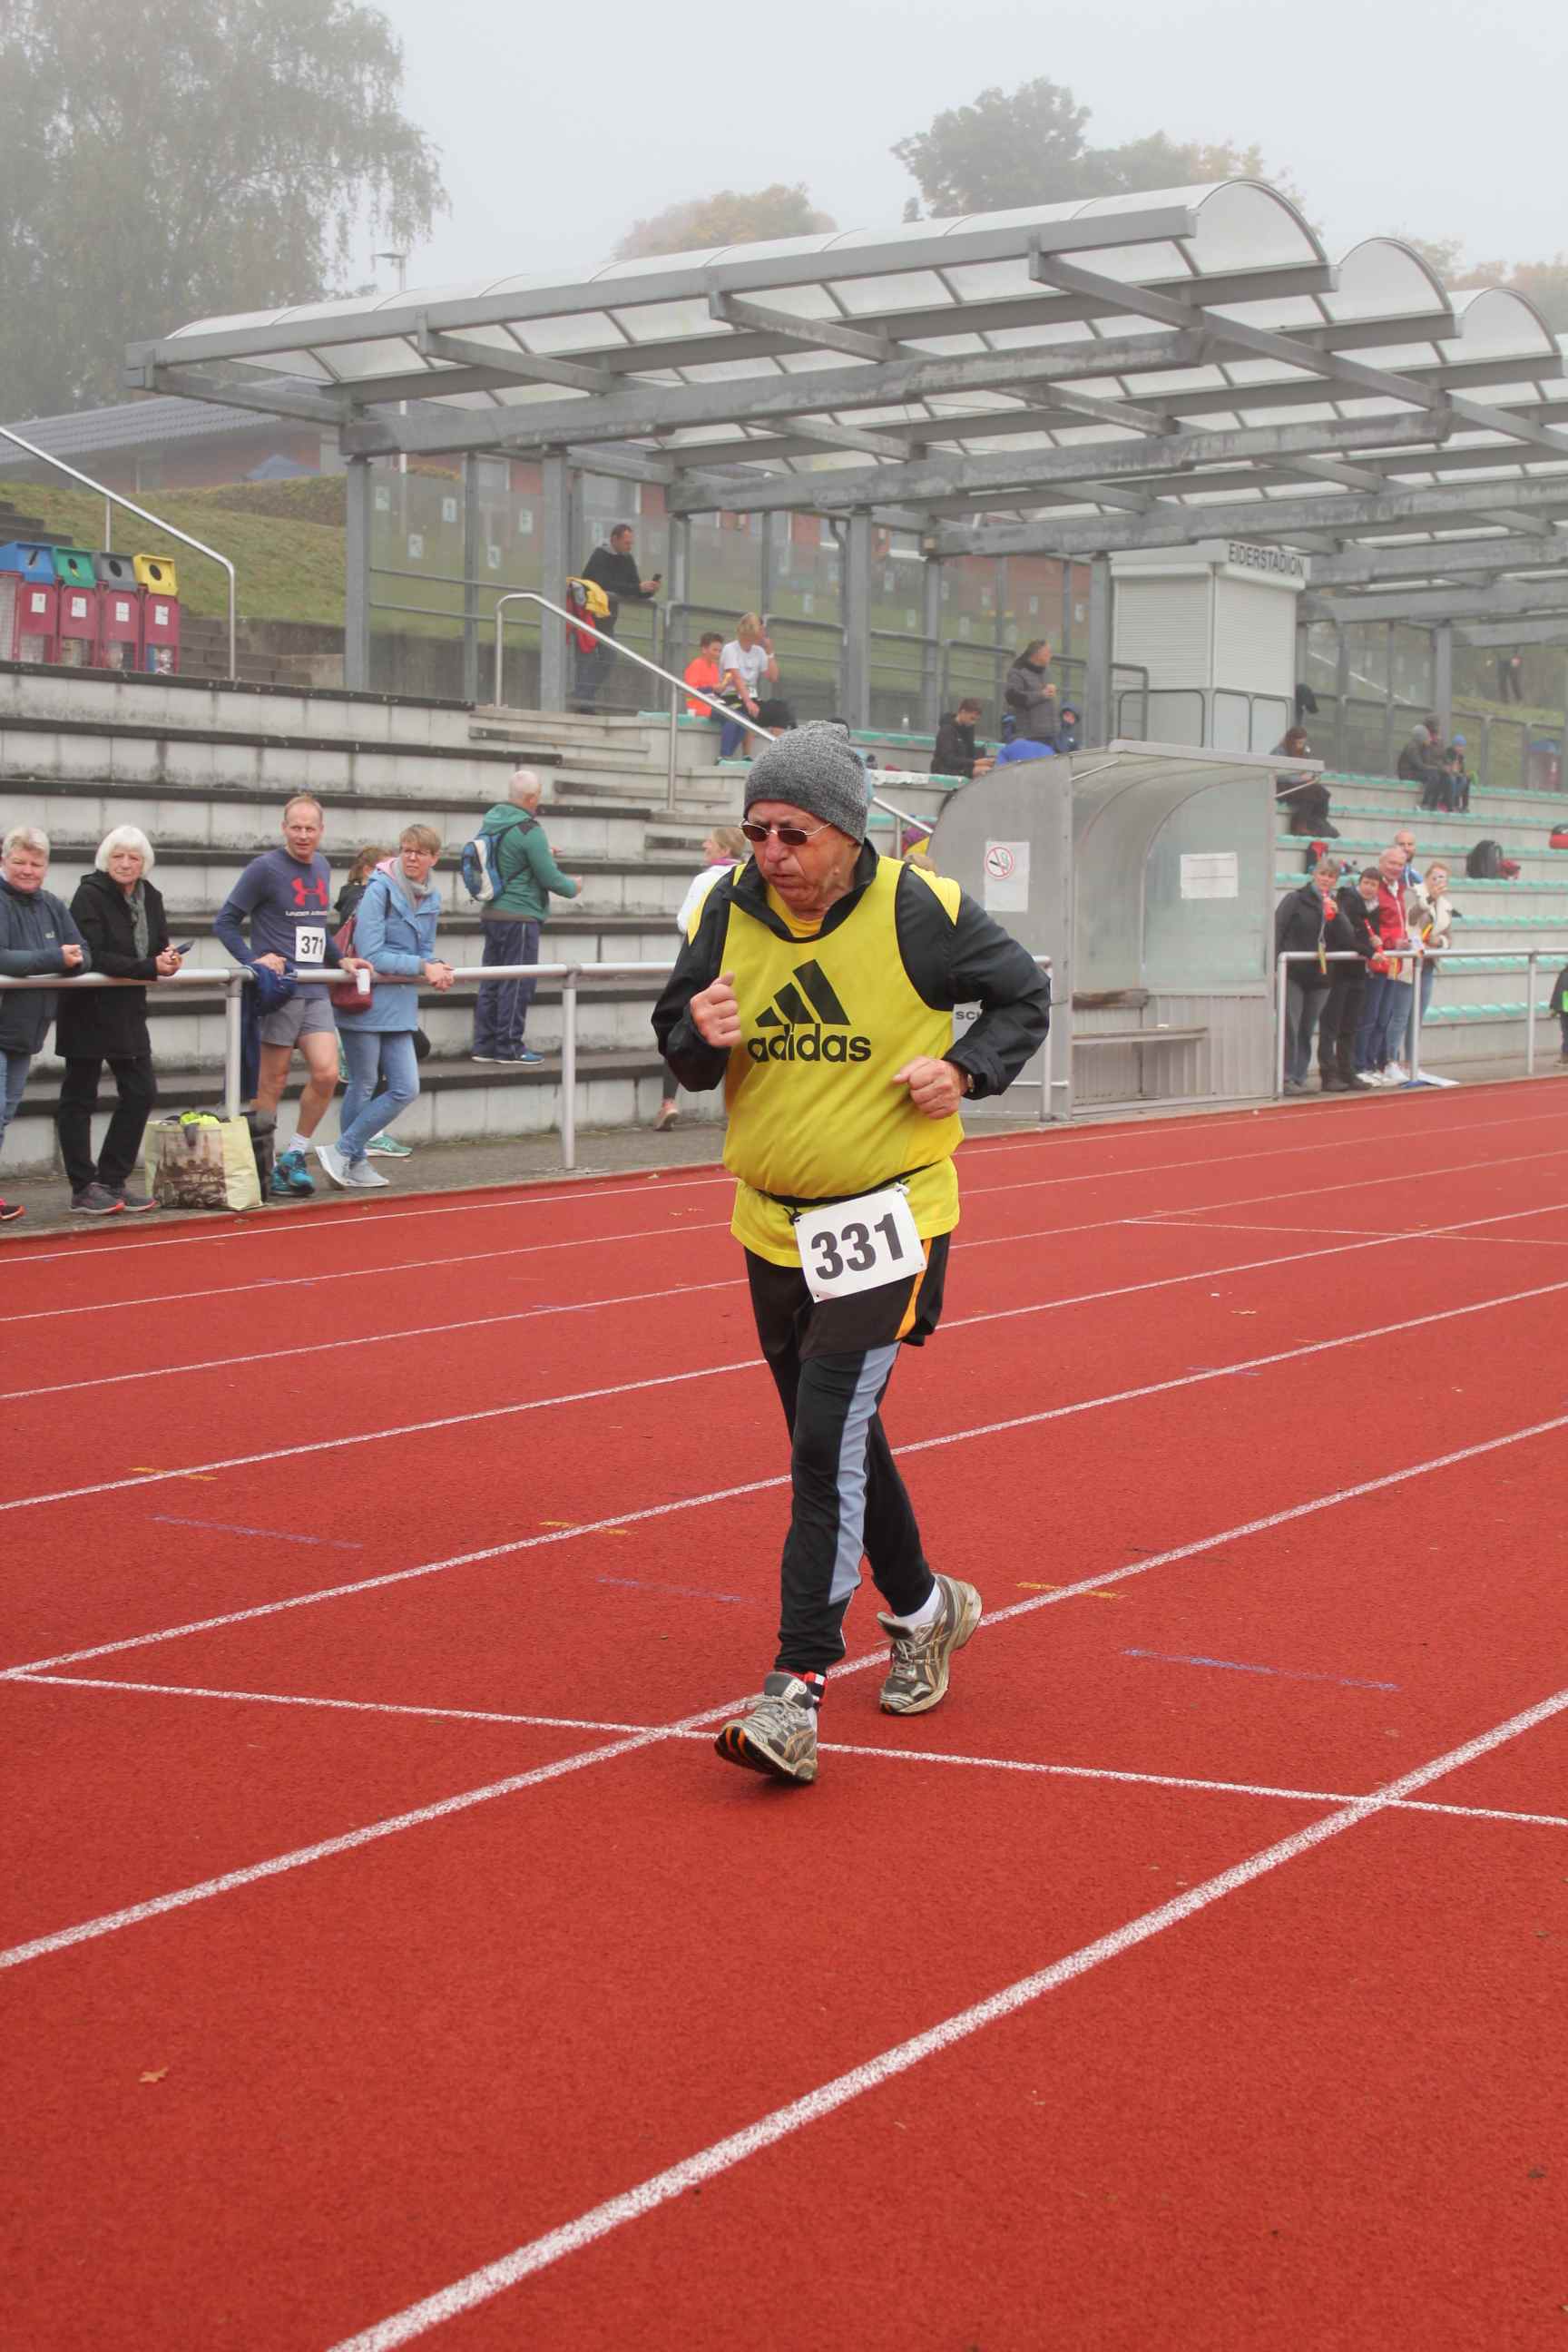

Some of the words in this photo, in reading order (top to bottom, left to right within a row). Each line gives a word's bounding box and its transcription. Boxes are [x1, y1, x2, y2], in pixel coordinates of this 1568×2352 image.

[1228, 543, 1304, 576] EIDERSTADION
[301, 936, 324, 955] 371
[747, 1022, 872, 1063] adidas
[810, 1212, 904, 1280] 331
